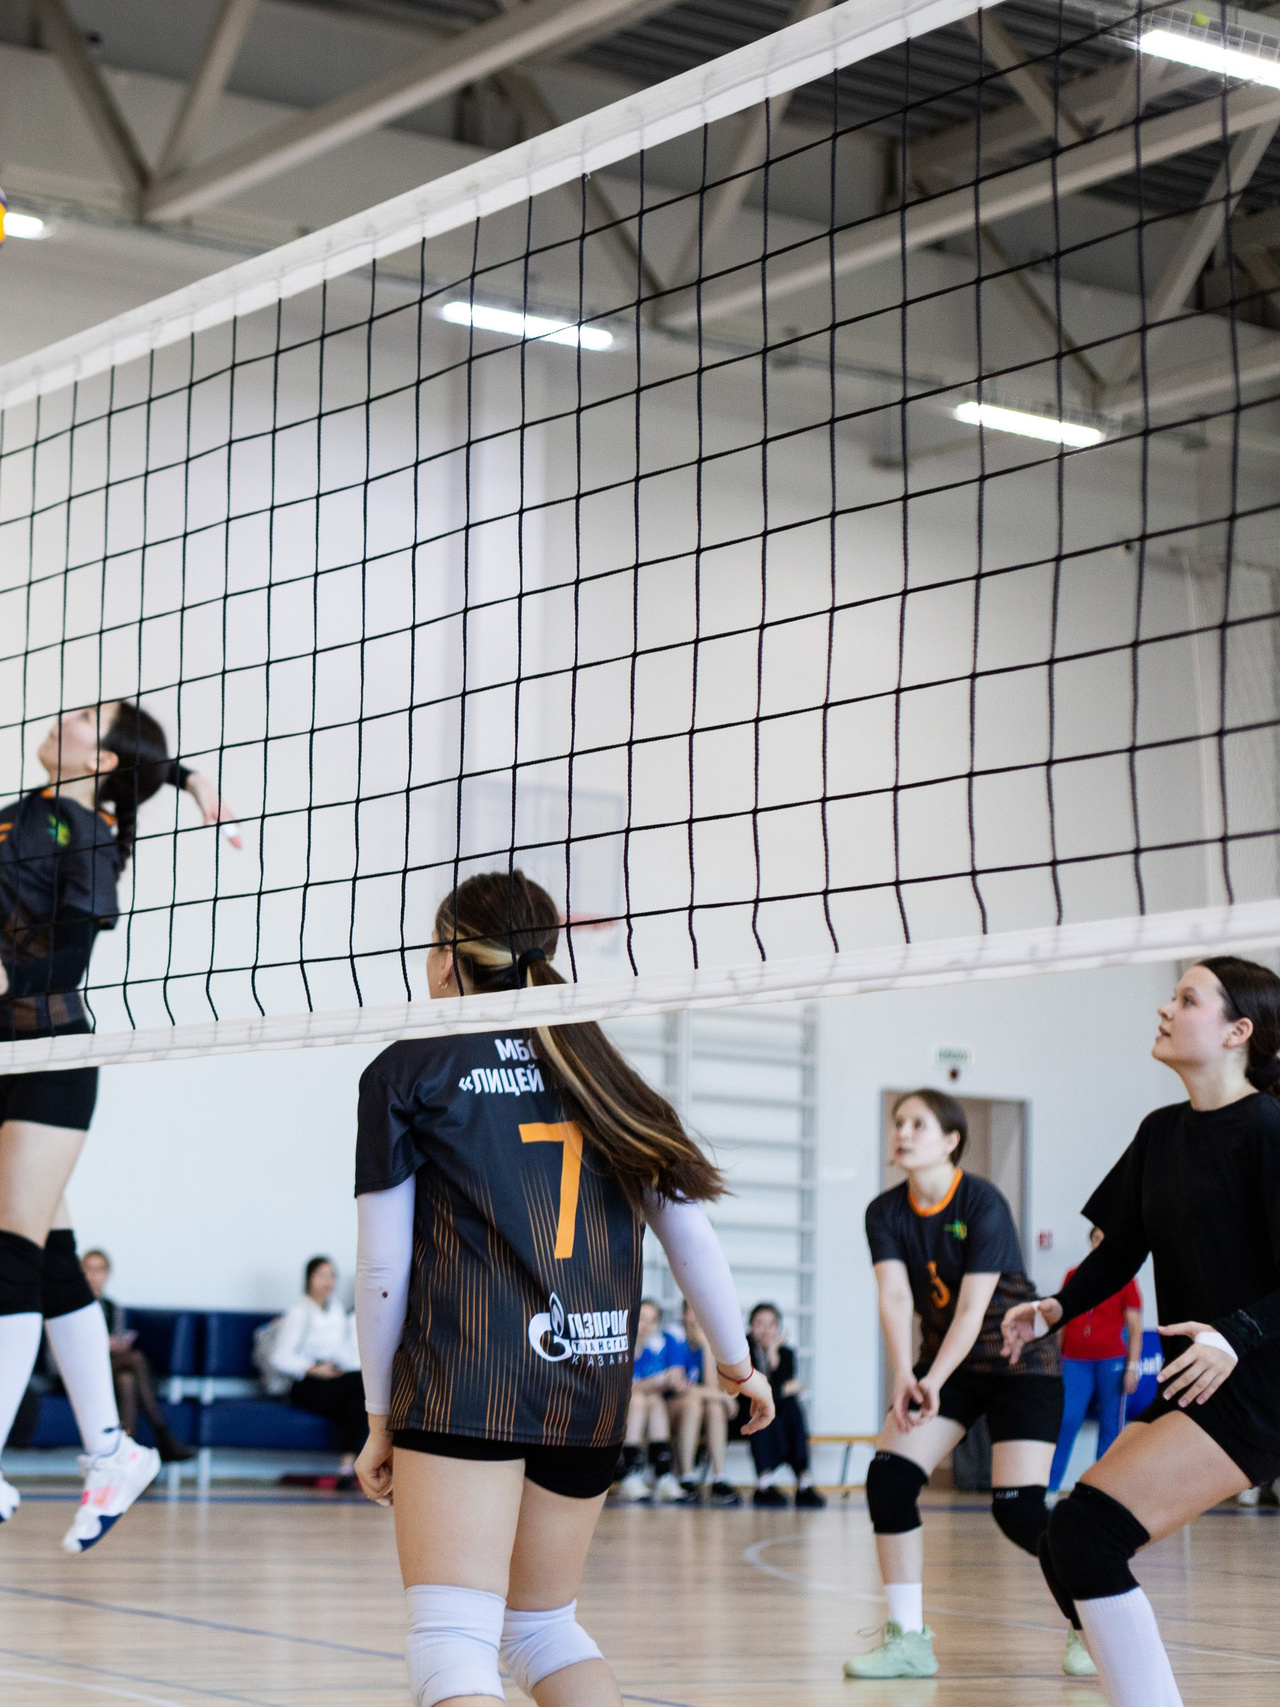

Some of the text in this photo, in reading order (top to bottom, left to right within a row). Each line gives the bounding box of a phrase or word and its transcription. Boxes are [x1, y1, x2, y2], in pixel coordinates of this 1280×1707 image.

[458, 1063, 545, 1097] «ЛИЦЕЙ
[519, 1121, 583, 1260] 7
[567, 1309, 629, 1339] ГАЗПРОМ
[571, 1353, 629, 1367] КАЗАНЬ
